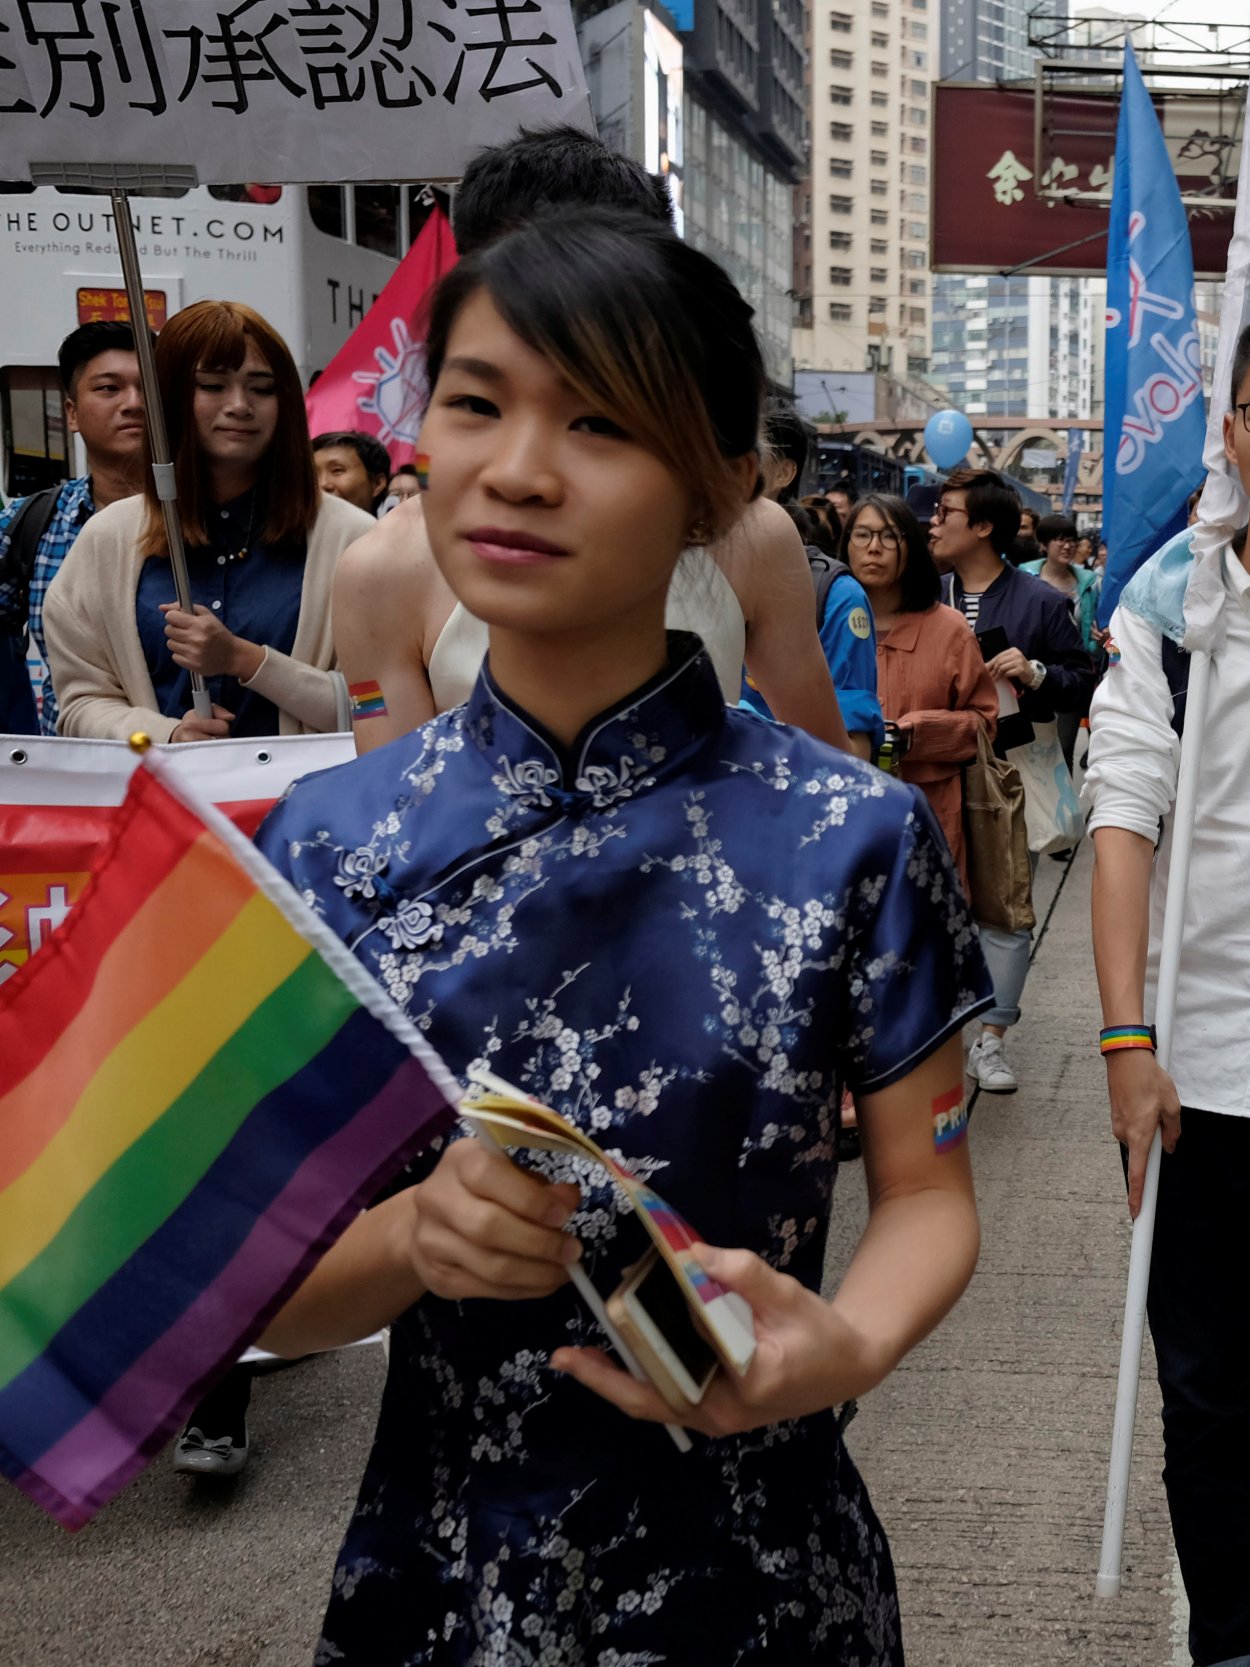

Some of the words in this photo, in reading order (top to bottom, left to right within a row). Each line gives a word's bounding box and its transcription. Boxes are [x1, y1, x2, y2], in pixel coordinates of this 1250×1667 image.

[0, 0, 562, 119] 別承認法
[0, 212, 37, 232] HE
[15, 241, 81, 256] Everything
[85, 241, 148, 256] Redud
[153, 244, 177, 257] But
[185, 246, 212, 259] The
[218, 248, 257, 262] Thrill
[79, 290, 107, 307] Shek
[326, 277, 380, 329] TH
